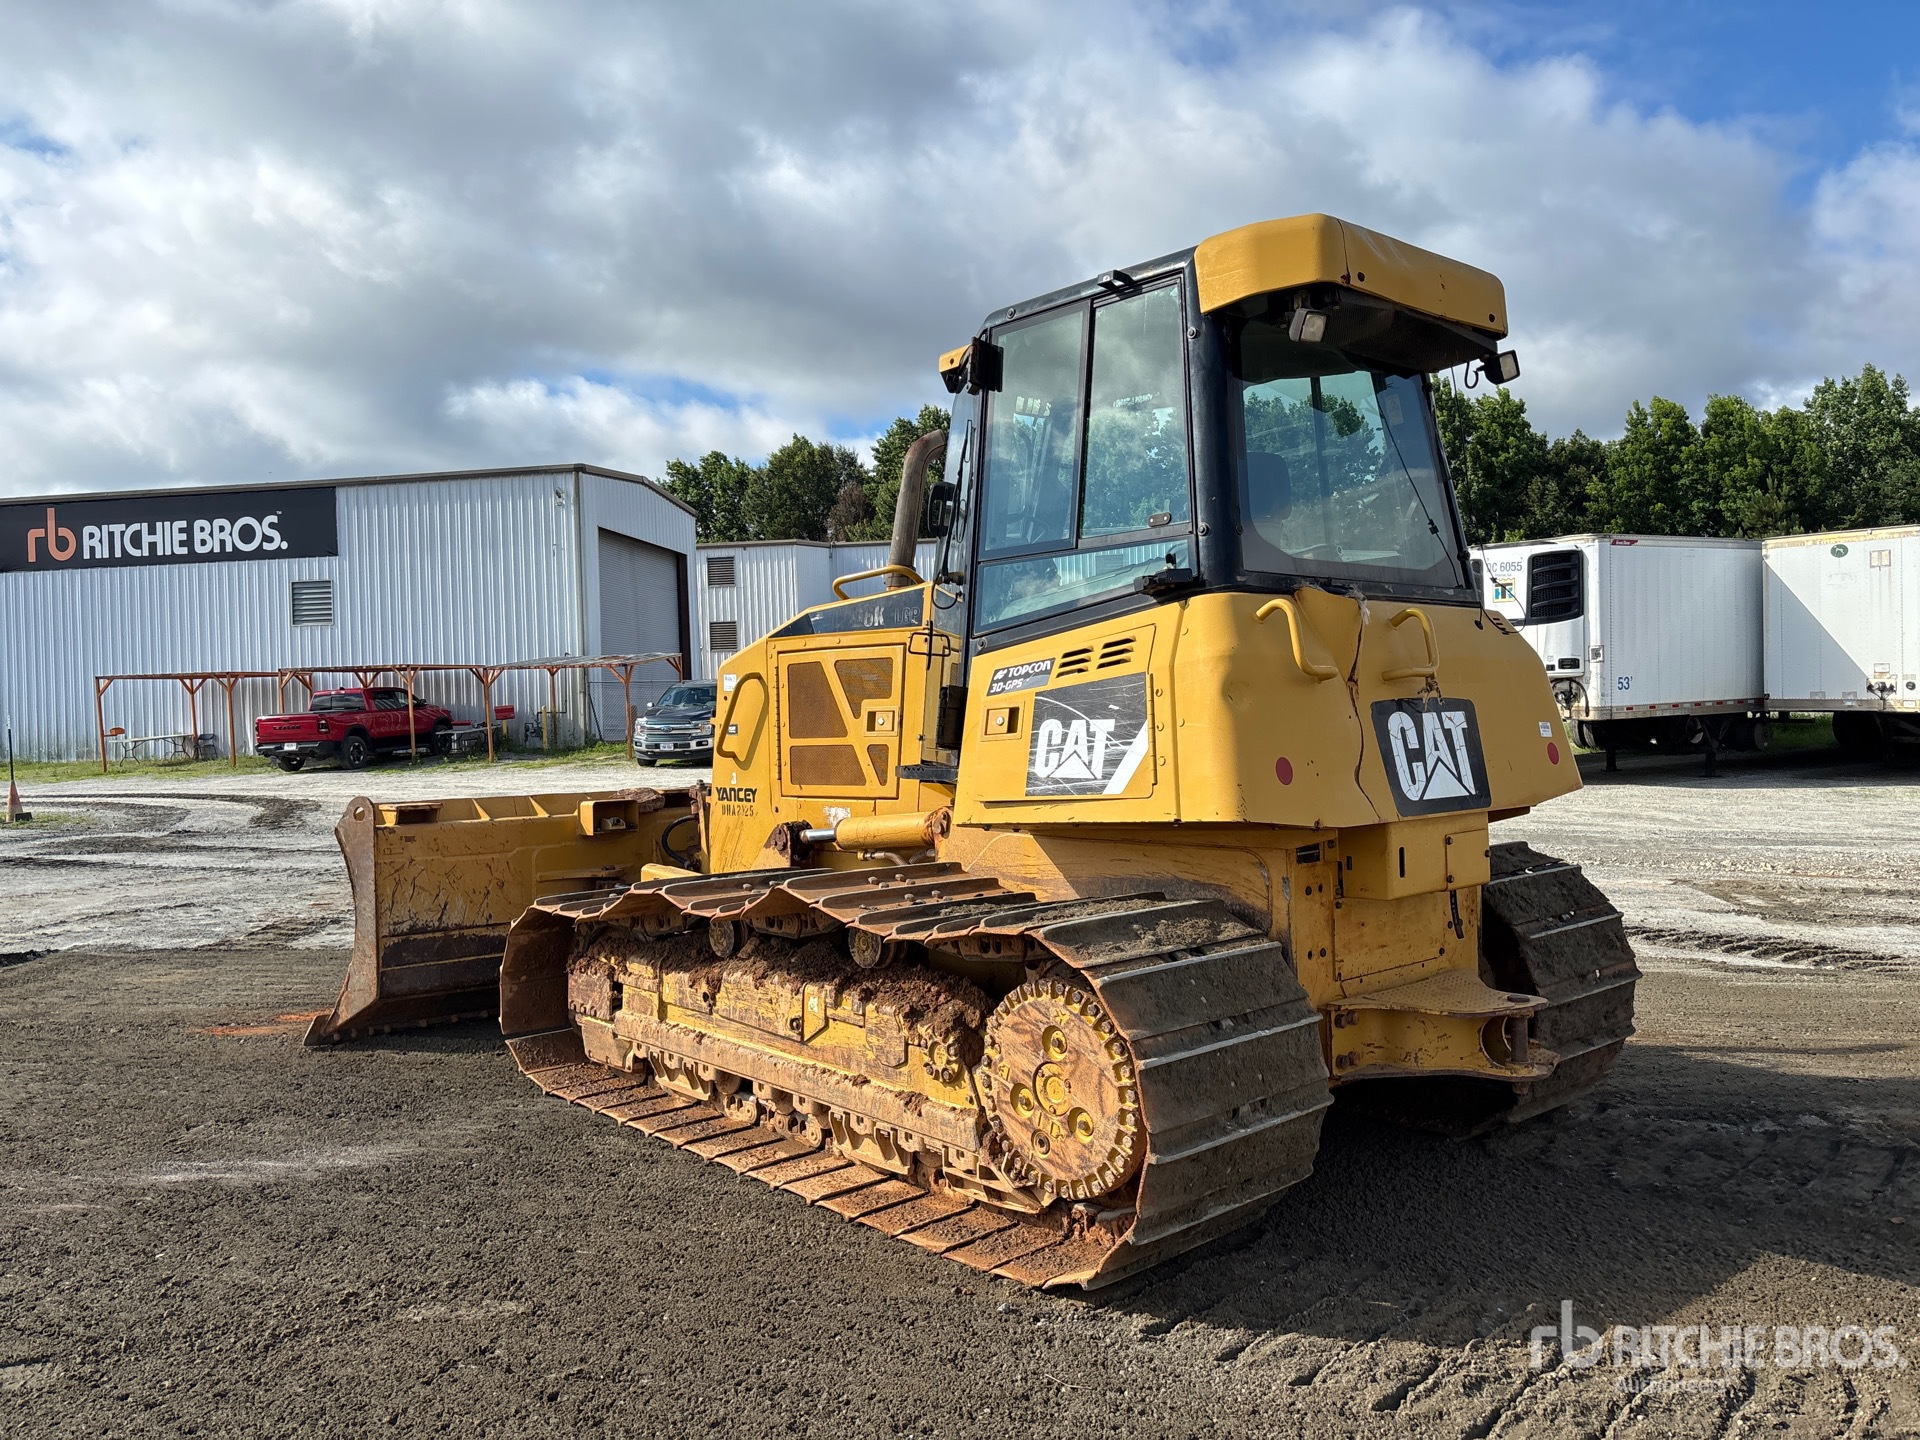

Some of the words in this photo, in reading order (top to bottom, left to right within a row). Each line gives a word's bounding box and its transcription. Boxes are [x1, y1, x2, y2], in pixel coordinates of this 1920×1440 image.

[27, 508, 77, 562] rb
[83, 519, 189, 559] RITCHIE
[193, 515, 289, 554] BROS.
[1500, 561, 1523, 572] 6055
[1008, 660, 1052, 678] TOPCON
[989, 678, 1024, 694] 3D-GPS
[1034, 718, 1116, 780] CAT
[1387, 711, 1477, 801] CAT
[715, 786, 758, 803] YANCEY
